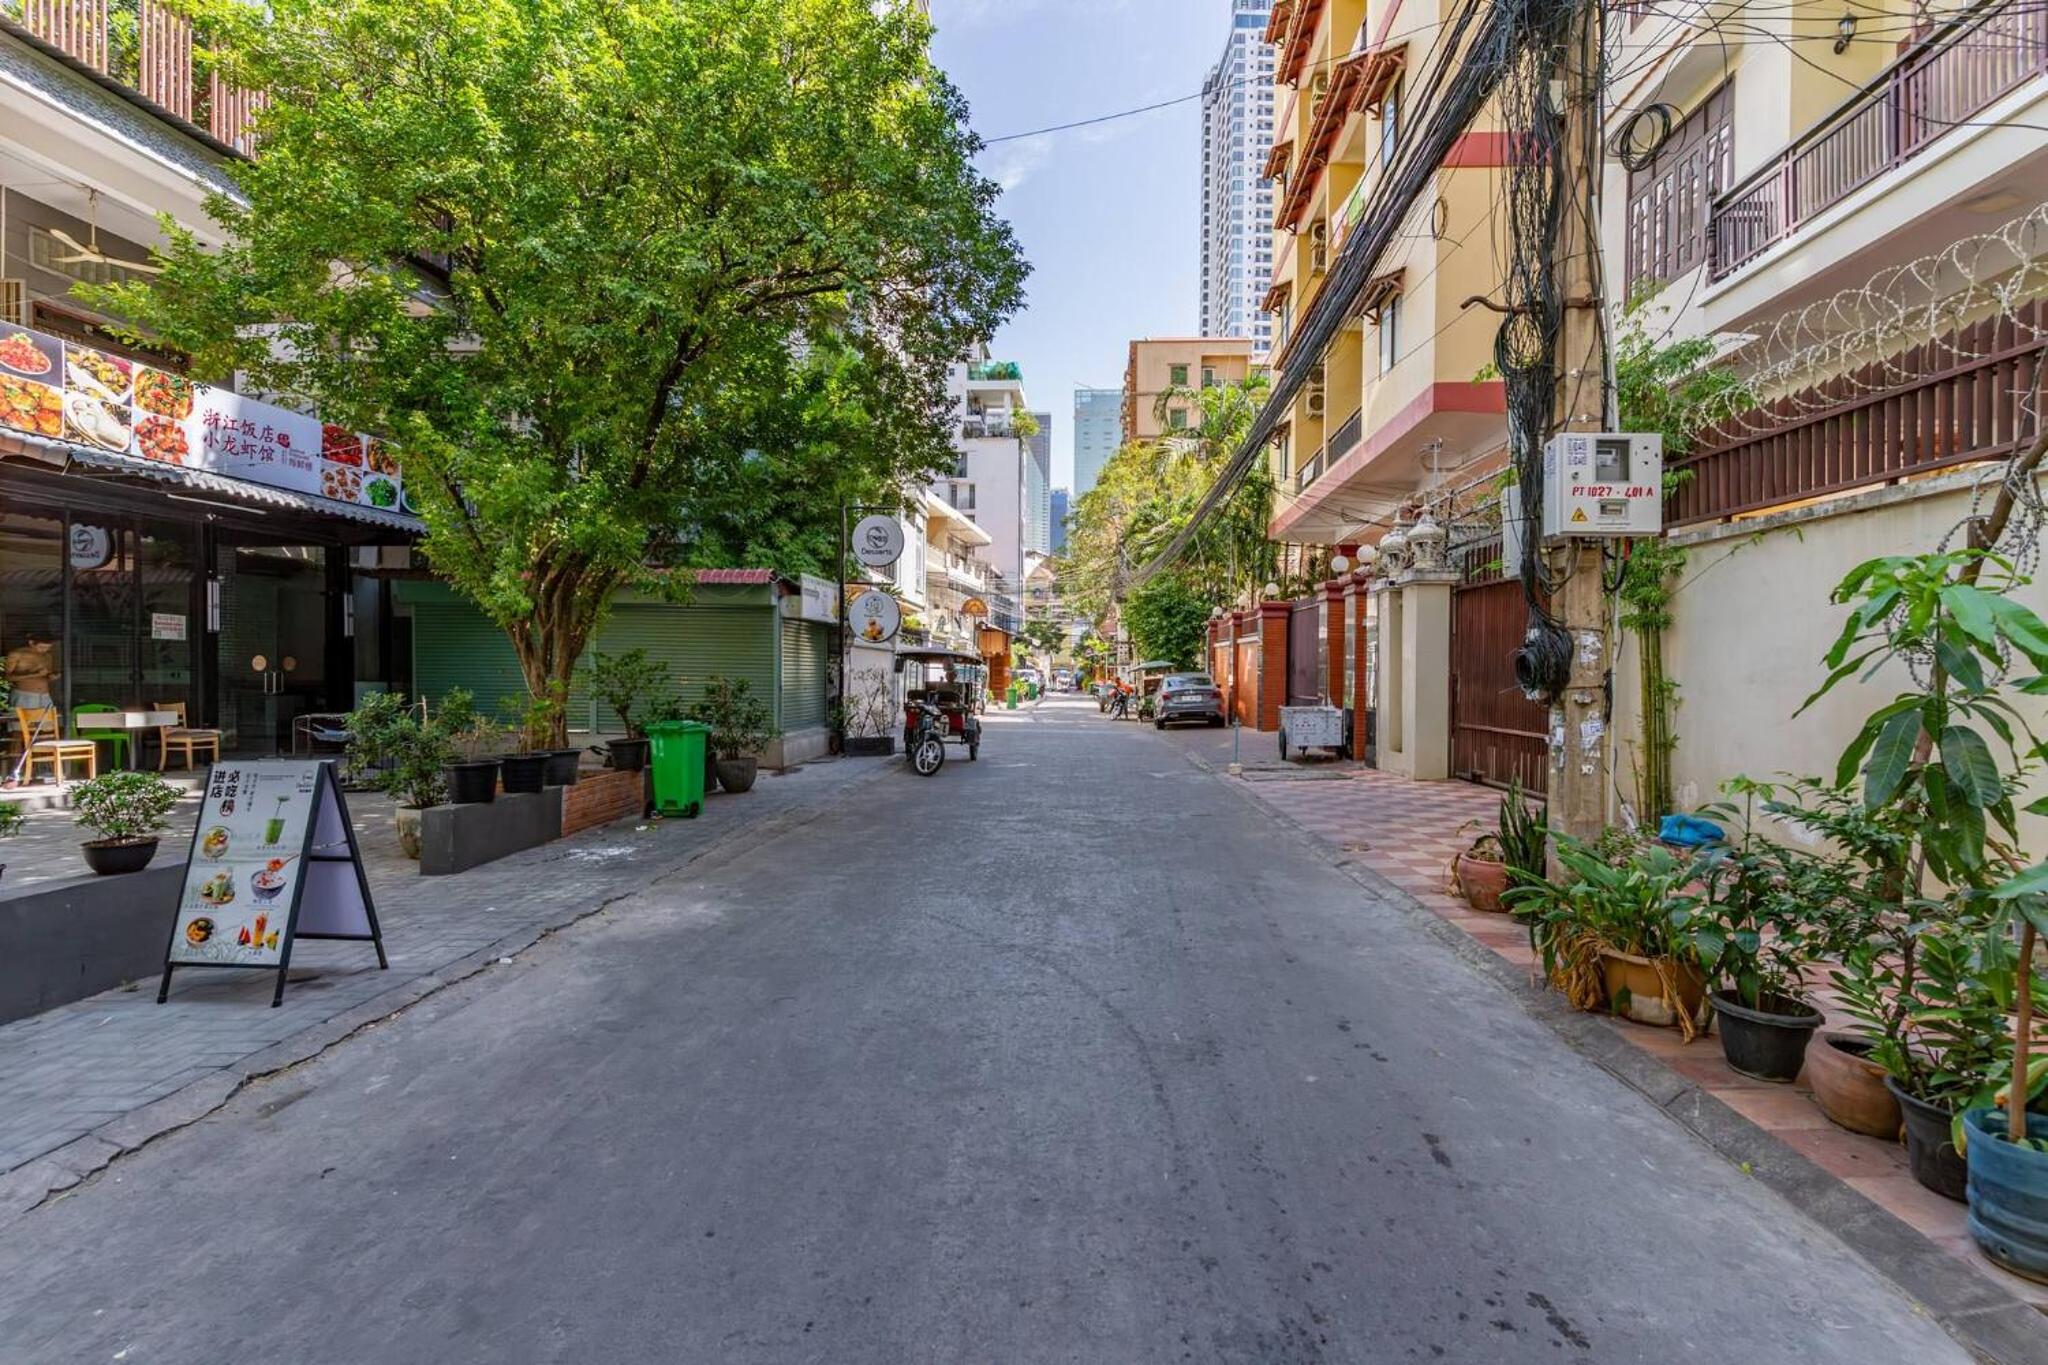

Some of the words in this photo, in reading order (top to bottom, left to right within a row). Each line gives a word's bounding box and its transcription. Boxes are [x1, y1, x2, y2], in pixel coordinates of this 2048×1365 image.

[203, 408, 274, 443] 浙江饭店
[203, 431, 275, 461] 小龙虾馆
[1588, 486, 1612, 497] 1027
[210, 770, 226, 798] 进店
